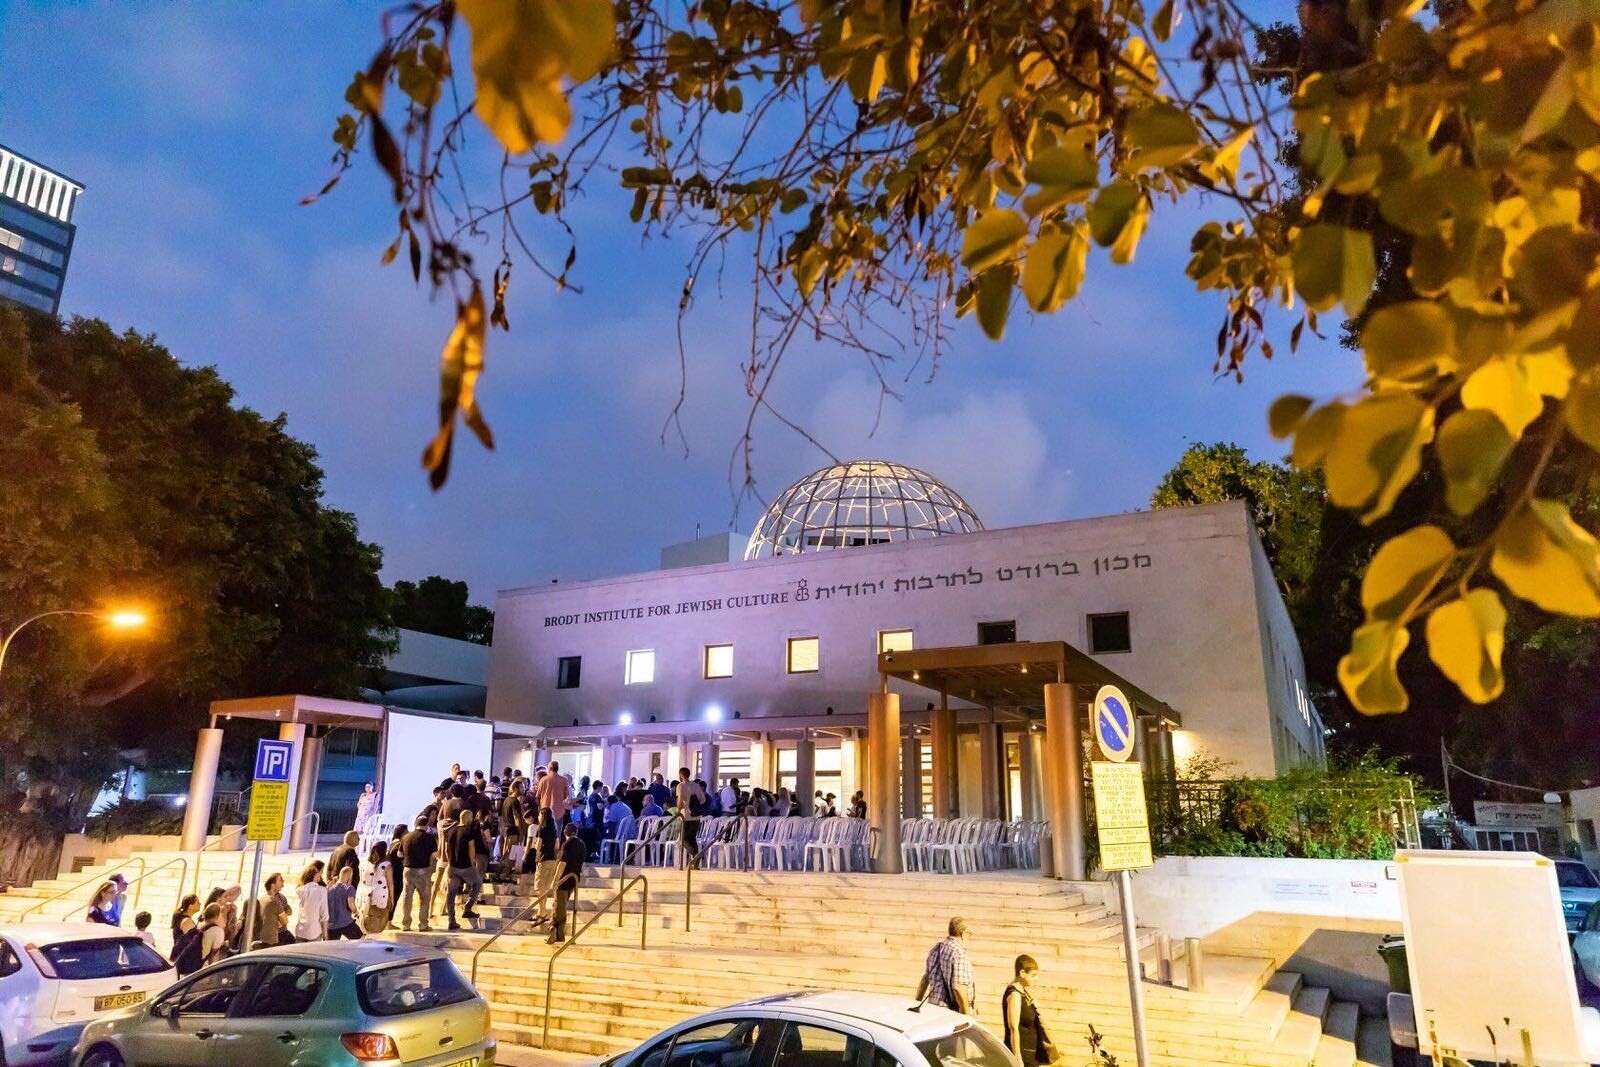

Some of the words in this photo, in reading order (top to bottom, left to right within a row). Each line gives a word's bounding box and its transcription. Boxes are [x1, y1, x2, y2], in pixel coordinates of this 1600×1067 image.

[996, 561, 1079, 581] ברודט
[1093, 553, 1152, 576] מכון
[815, 580, 884, 599] יהודית
[894, 566, 983, 592] לתרבות
[544, 614, 580, 627] BRODT
[584, 607, 644, 624] INSTITUTE
[648, 604, 670, 617] FOR
[675, 599, 722, 614] JEWISH
[726, 592, 789, 609] CULTURE
[268, 753, 282, 775] P
